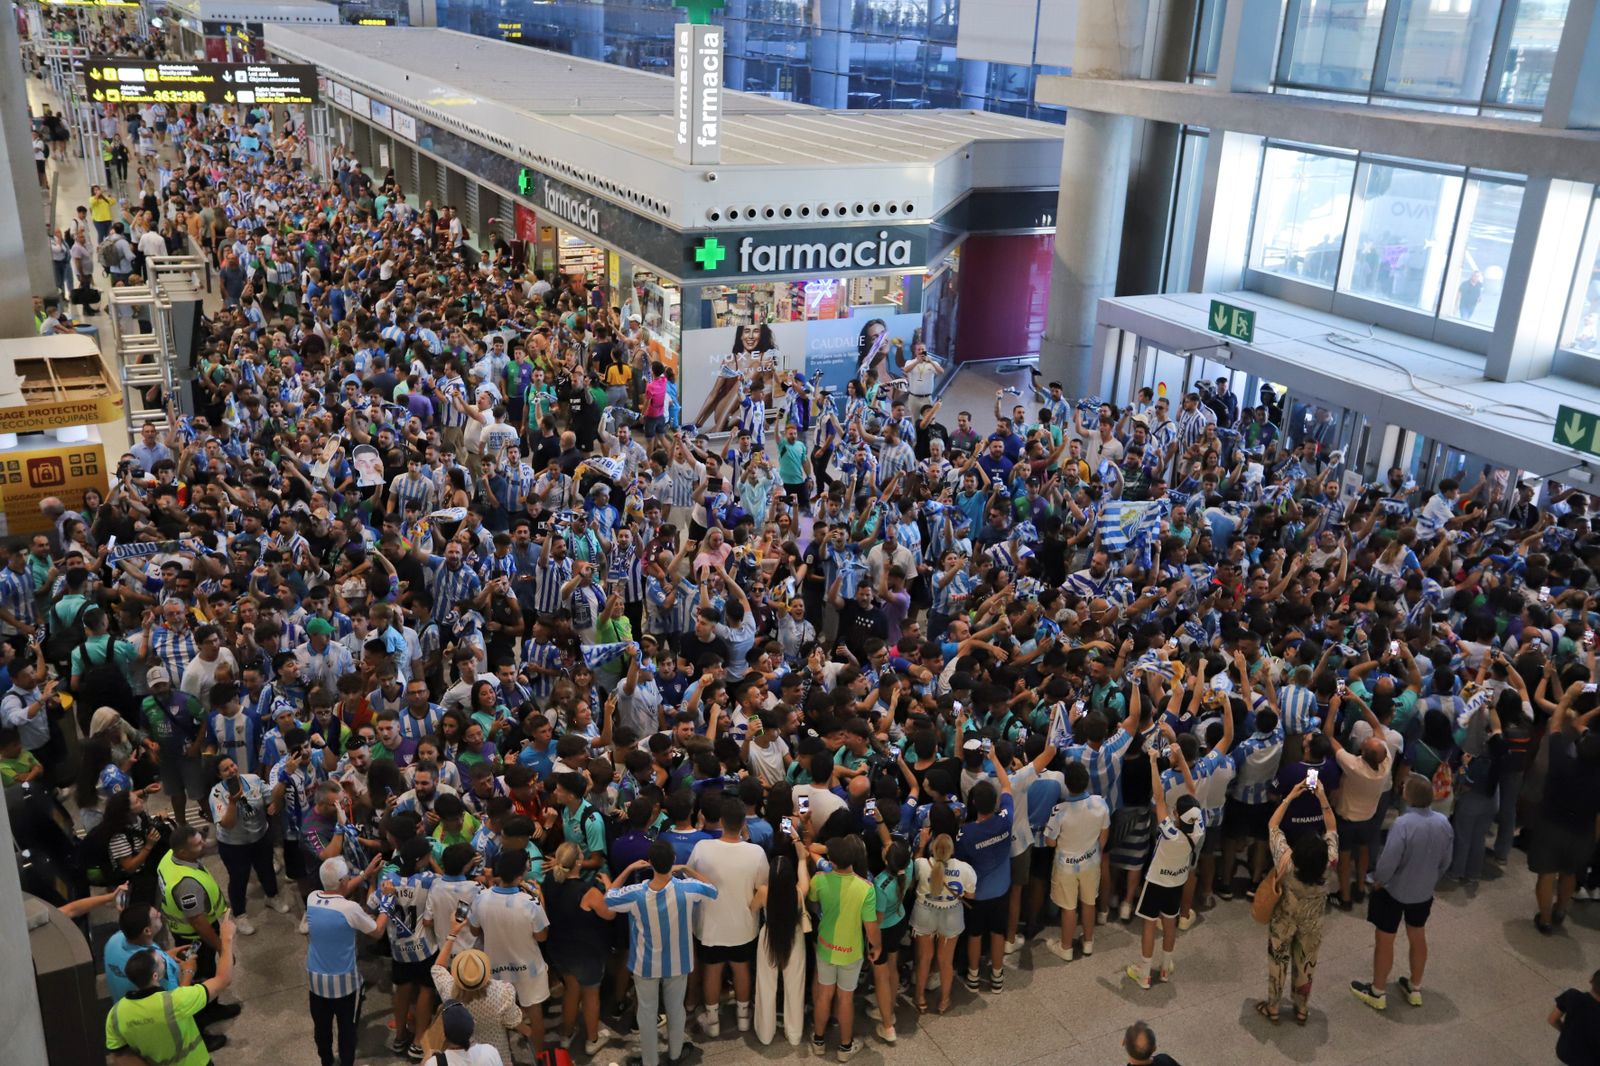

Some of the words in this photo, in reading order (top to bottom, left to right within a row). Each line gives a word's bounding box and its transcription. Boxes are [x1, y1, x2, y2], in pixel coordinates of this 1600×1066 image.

[677, 31, 688, 144] farmacia
[697, 32, 719, 148] farmacia
[153, 90, 177, 102] 363
[182, 90, 205, 102] 386
[544, 179, 599, 234] farmacia
[740, 231, 911, 273] farmacia
[28, 403, 97, 418] PROTECTION
[48, 412, 99, 425] EQUIPAJES
[1291, 815, 1325, 823] BENAHAVI
[492, 964, 527, 974] NAHAVIS
